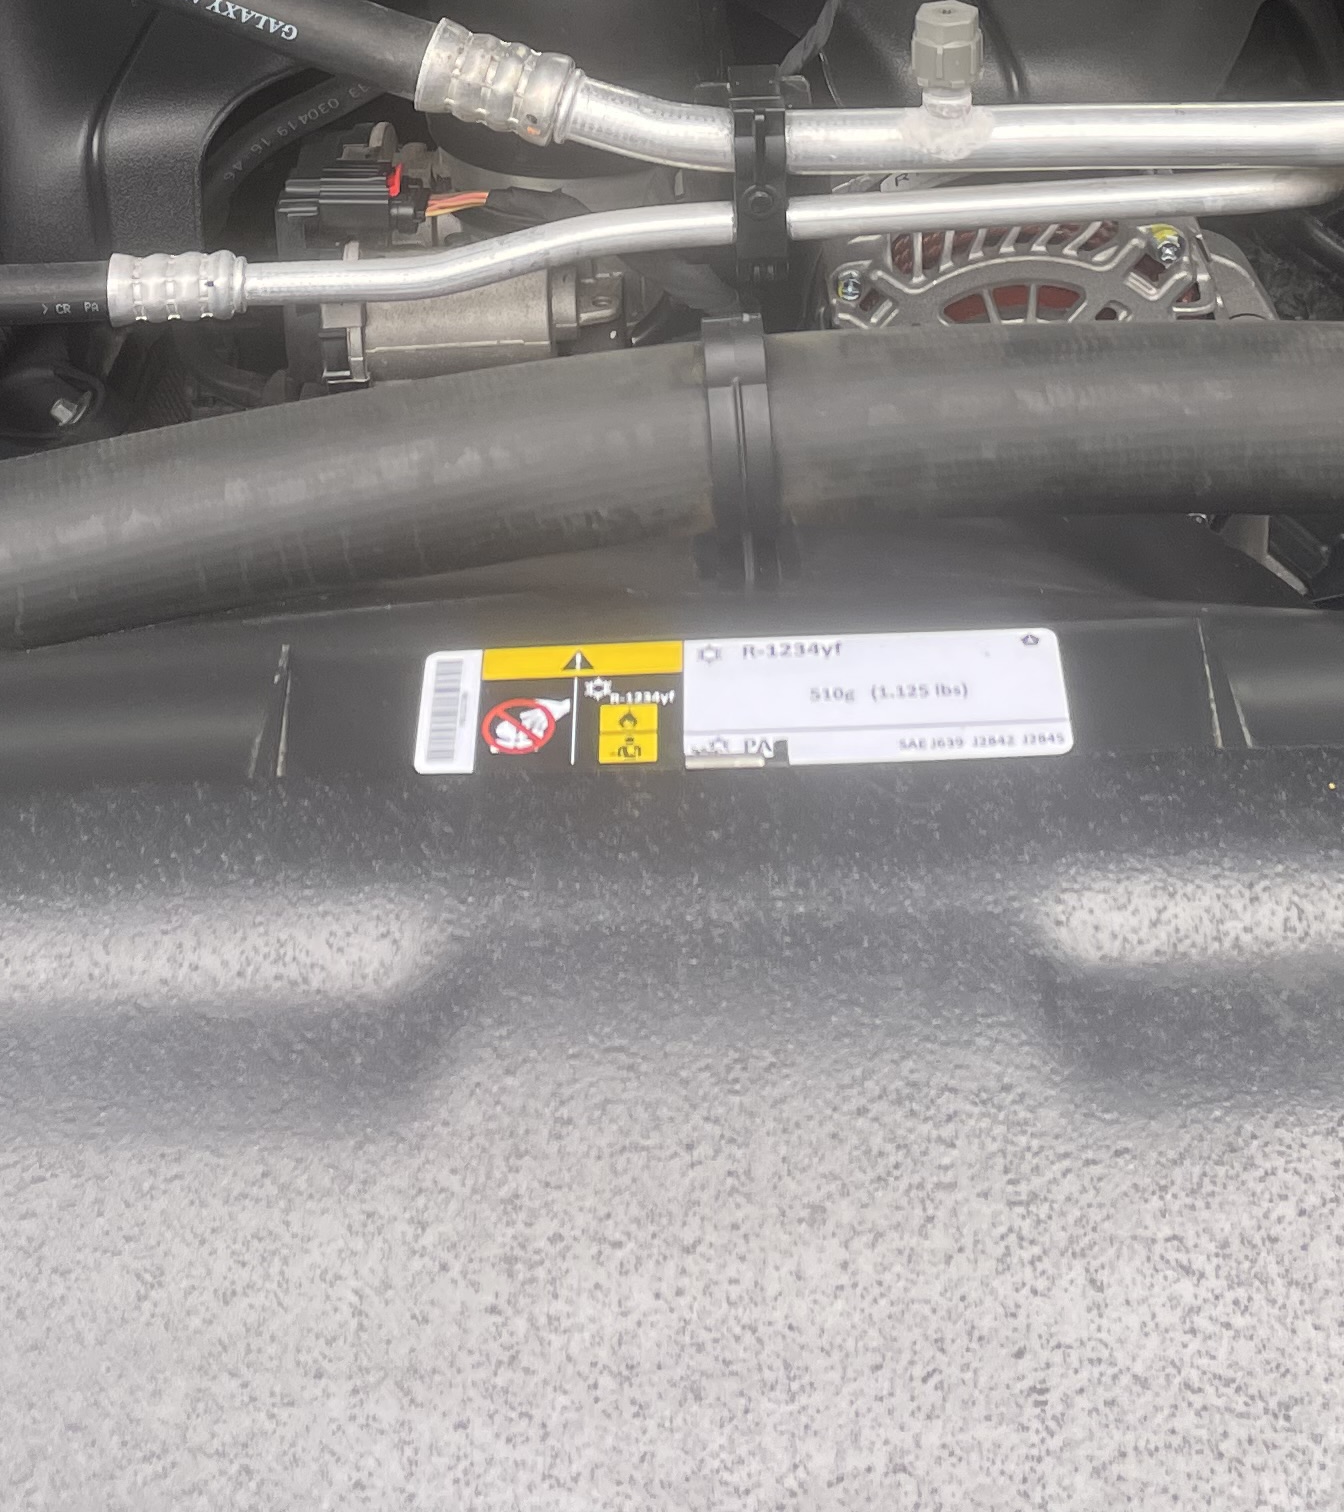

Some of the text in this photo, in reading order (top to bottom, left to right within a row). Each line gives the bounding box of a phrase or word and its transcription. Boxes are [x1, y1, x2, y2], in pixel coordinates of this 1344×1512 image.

[276, 98, 340, 136] 030419
[55, 303, 71, 315] CR
[83, 301, 100, 313] PA
[742, 641, 843, 661] R-1234yf
[809, 680, 969, 705] 510g (1.125 lbs)
[898, 737, 927, 752] SAE
